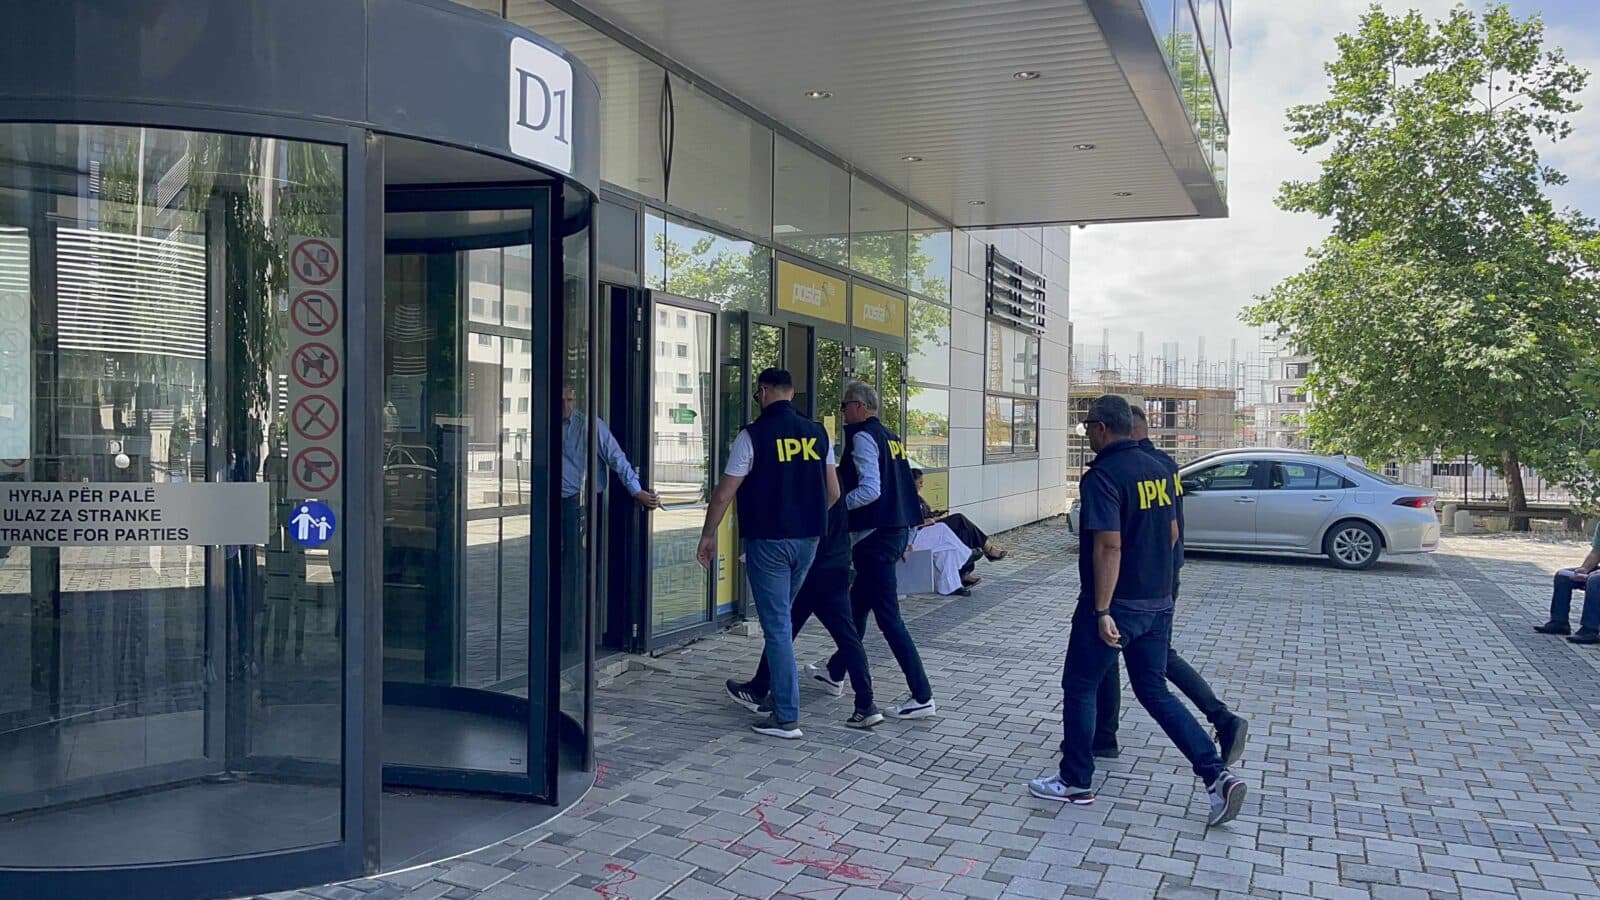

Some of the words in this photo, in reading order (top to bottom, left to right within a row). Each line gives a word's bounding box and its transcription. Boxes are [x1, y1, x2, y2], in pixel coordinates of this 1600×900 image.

[515, 67, 569, 145] D1
[776, 437, 821, 462] IPK
[9, 489, 64, 502] HYRJA
[68, 486, 103, 502] PËR
[109, 487, 155, 502] PALË
[1137, 478, 1172, 509] IPK
[3, 509, 46, 522] ULAZ
[50, 509, 73, 522] ZA
[77, 509, 162, 522] STRANKE
[73, 528, 109, 541] FOR
[115, 528, 189, 541] PARTIES
